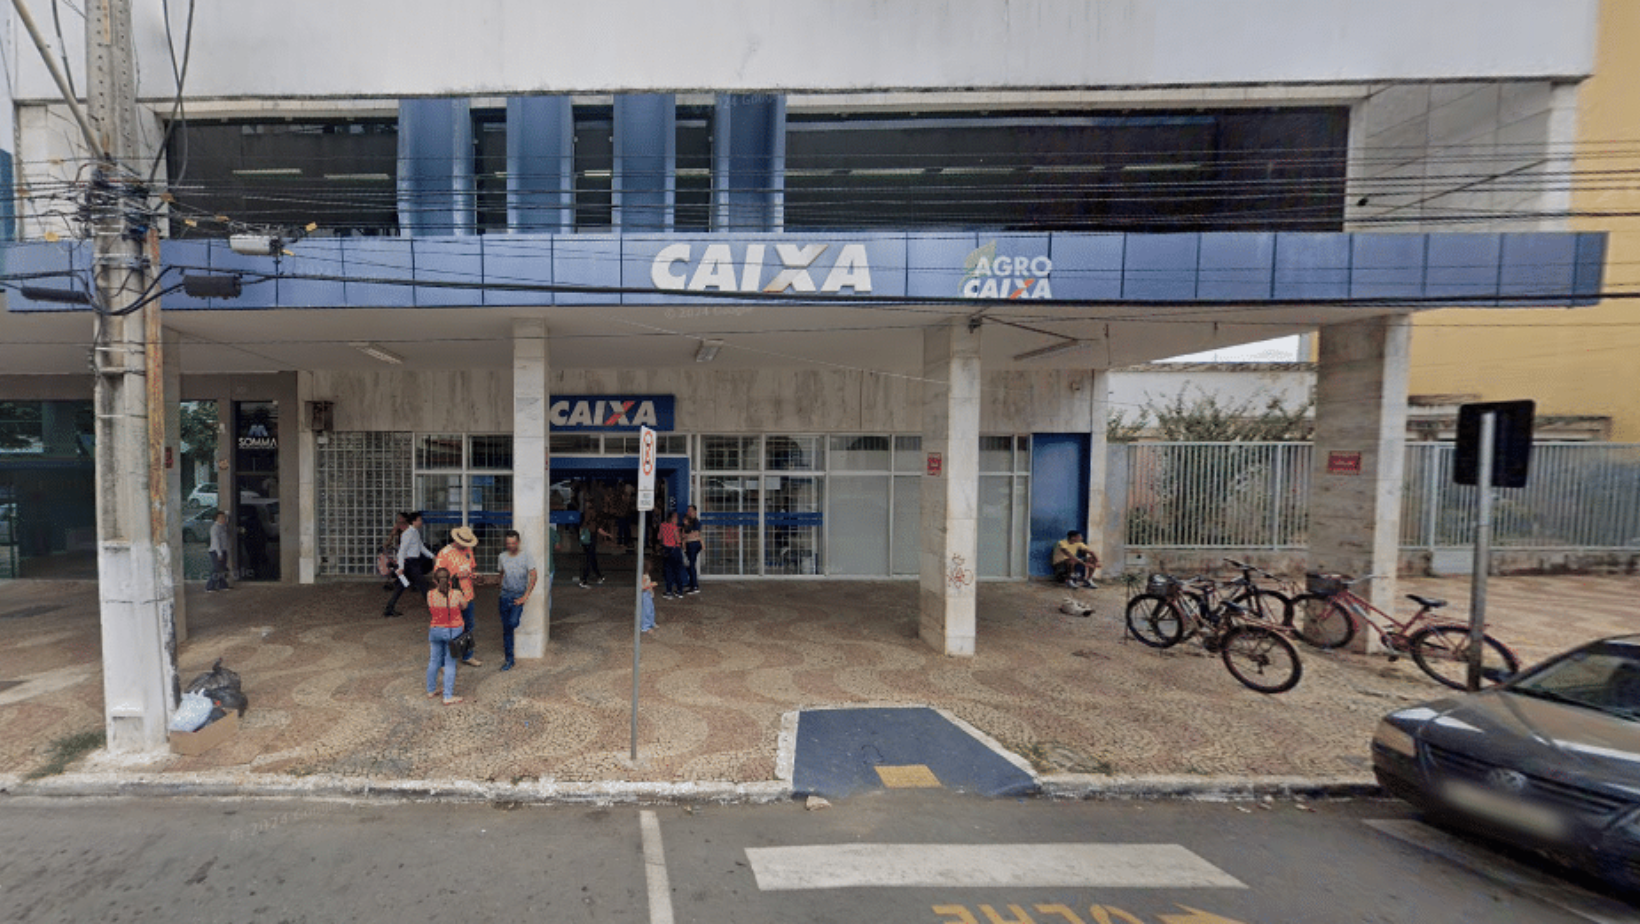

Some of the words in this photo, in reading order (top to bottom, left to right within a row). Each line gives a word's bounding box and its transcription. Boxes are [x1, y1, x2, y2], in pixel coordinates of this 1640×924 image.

[651, 243, 873, 293] CAIXA
[974, 255, 1053, 277] AGRO
[963, 278, 1053, 299] CAIXA
[549, 400, 658, 426] CAIXA
[238, 437, 277, 448] SOMMA
